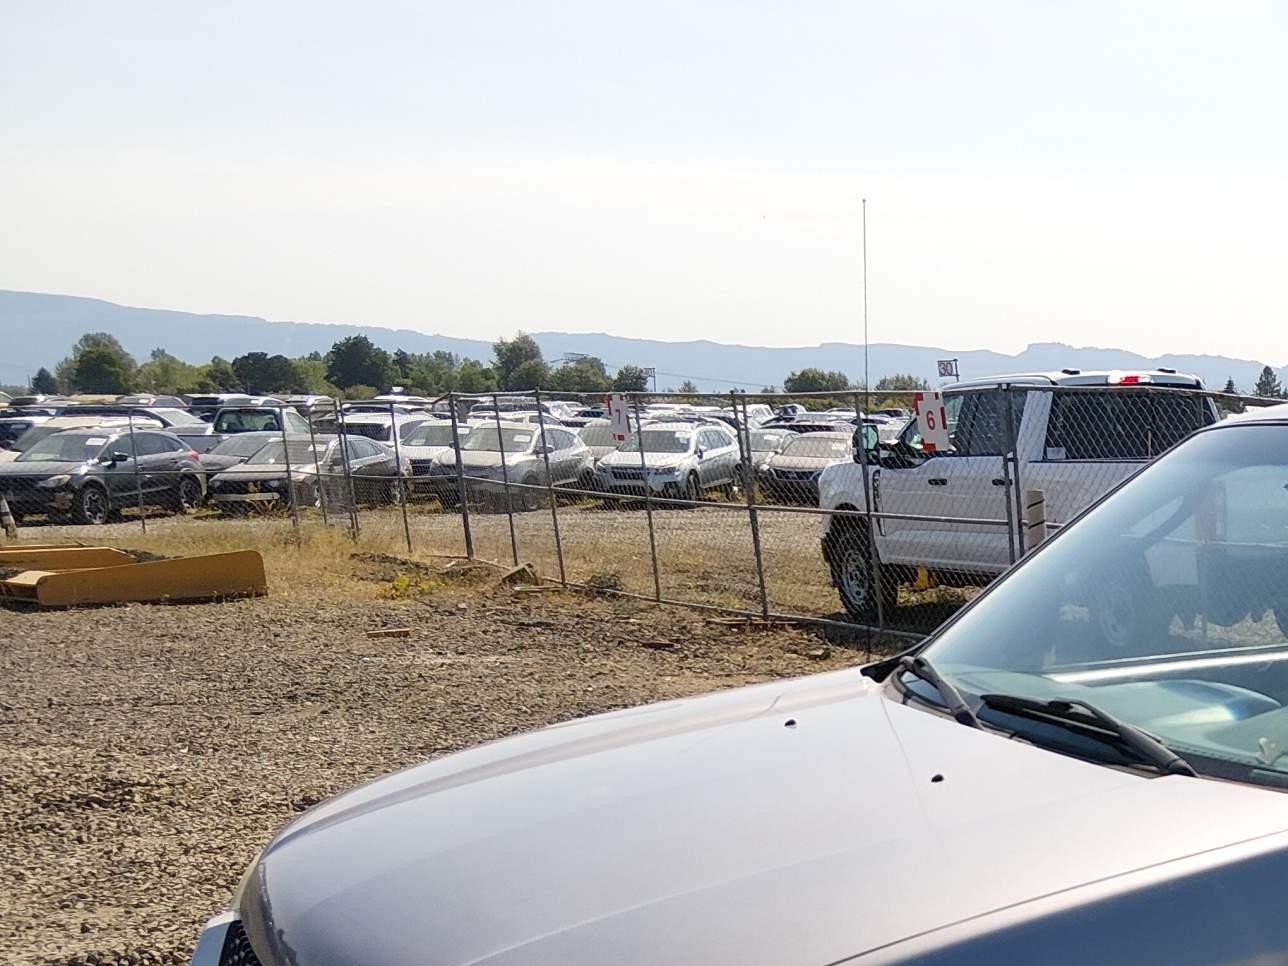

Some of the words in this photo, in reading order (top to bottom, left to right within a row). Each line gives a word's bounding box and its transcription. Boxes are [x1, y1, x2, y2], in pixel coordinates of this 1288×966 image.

[939, 362, 954, 376] 30
[615, 408, 621, 425] 7
[926, 410, 936, 430] 6
